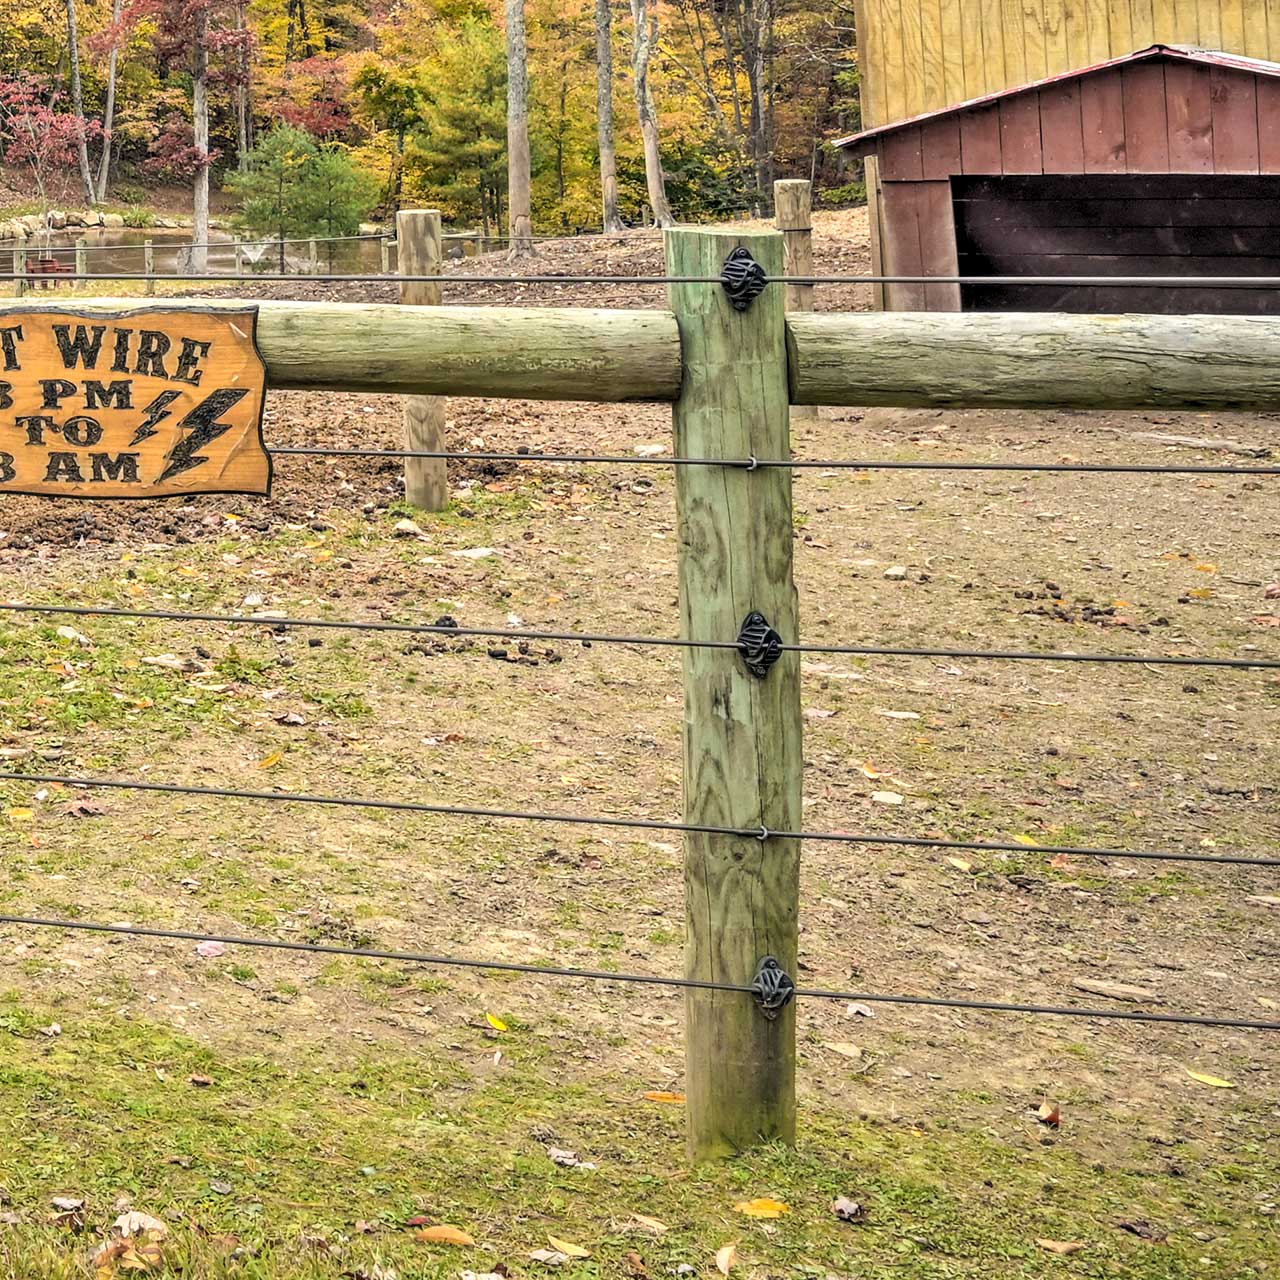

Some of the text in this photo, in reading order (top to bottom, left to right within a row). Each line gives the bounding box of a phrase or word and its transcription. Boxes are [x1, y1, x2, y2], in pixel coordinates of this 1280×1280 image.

[52, 324, 212, 387] WIRE
[38, 379, 135, 410] PM
[15, 415, 104, 447] TO
[42, 451, 142, 483] AM
